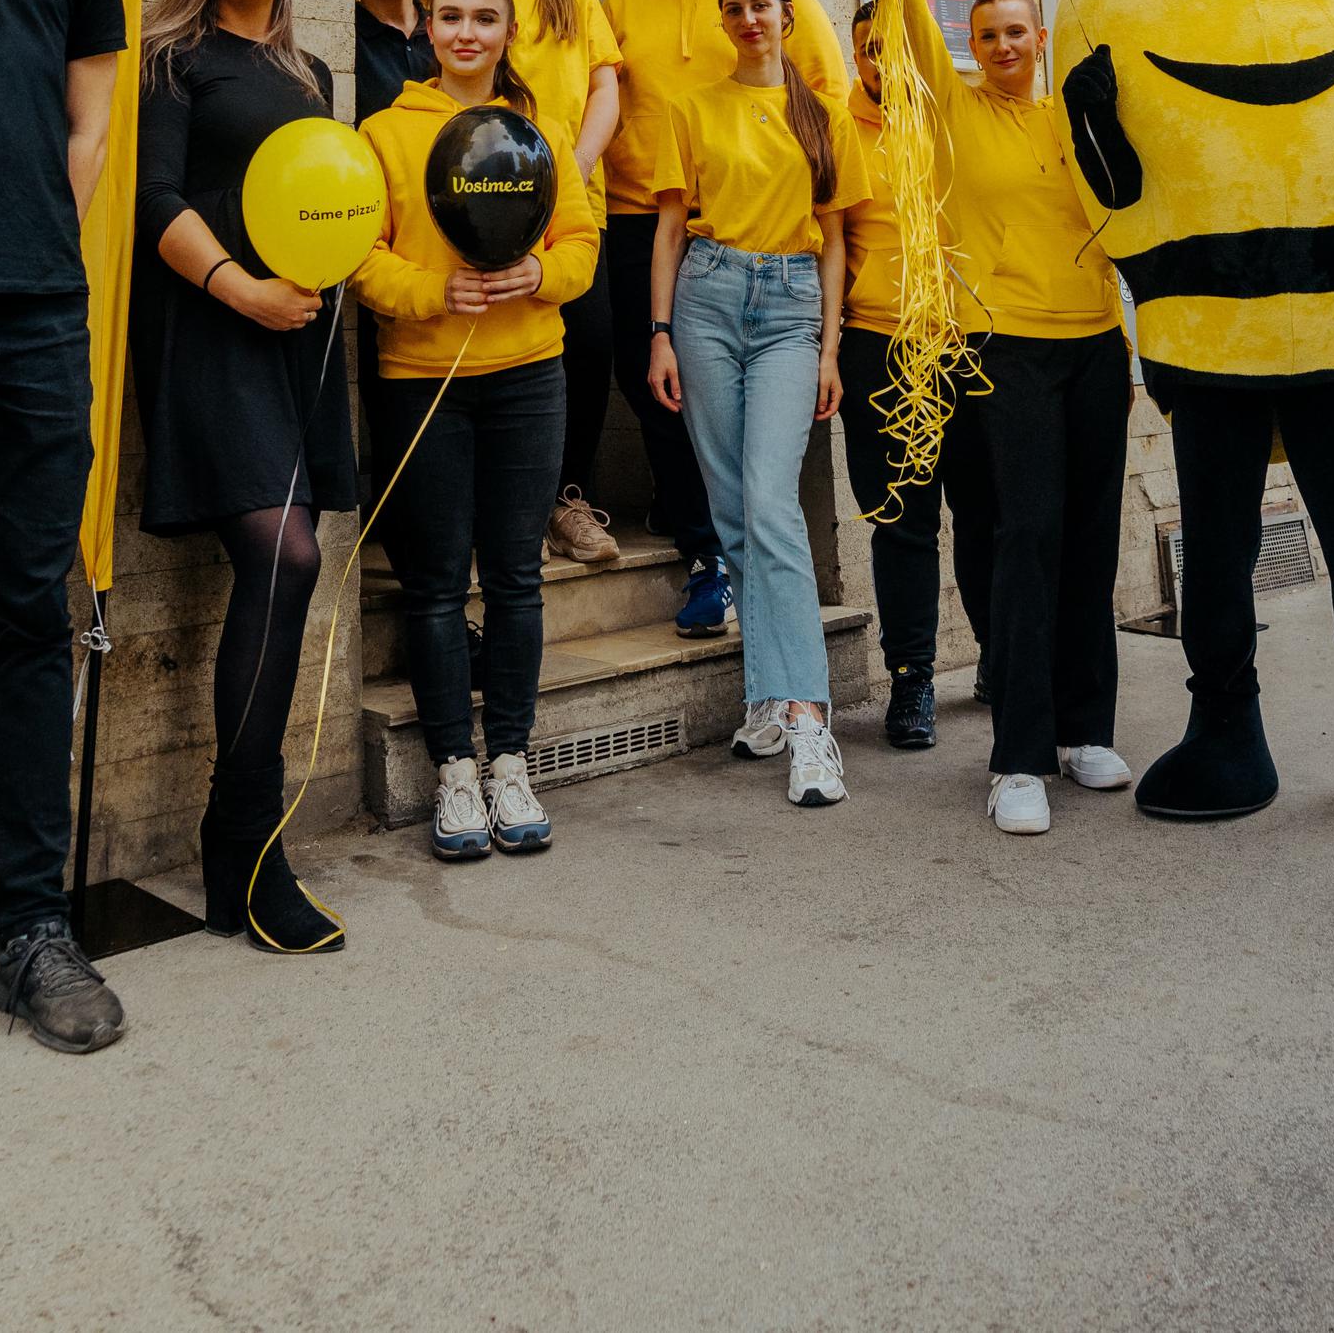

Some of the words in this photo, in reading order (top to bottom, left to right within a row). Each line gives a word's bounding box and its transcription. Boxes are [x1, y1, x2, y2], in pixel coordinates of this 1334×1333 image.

[452, 176, 534, 194] Vosíme.cz
[299, 207, 344, 222] Dáme
[347, 200, 381, 221] pizzu?
